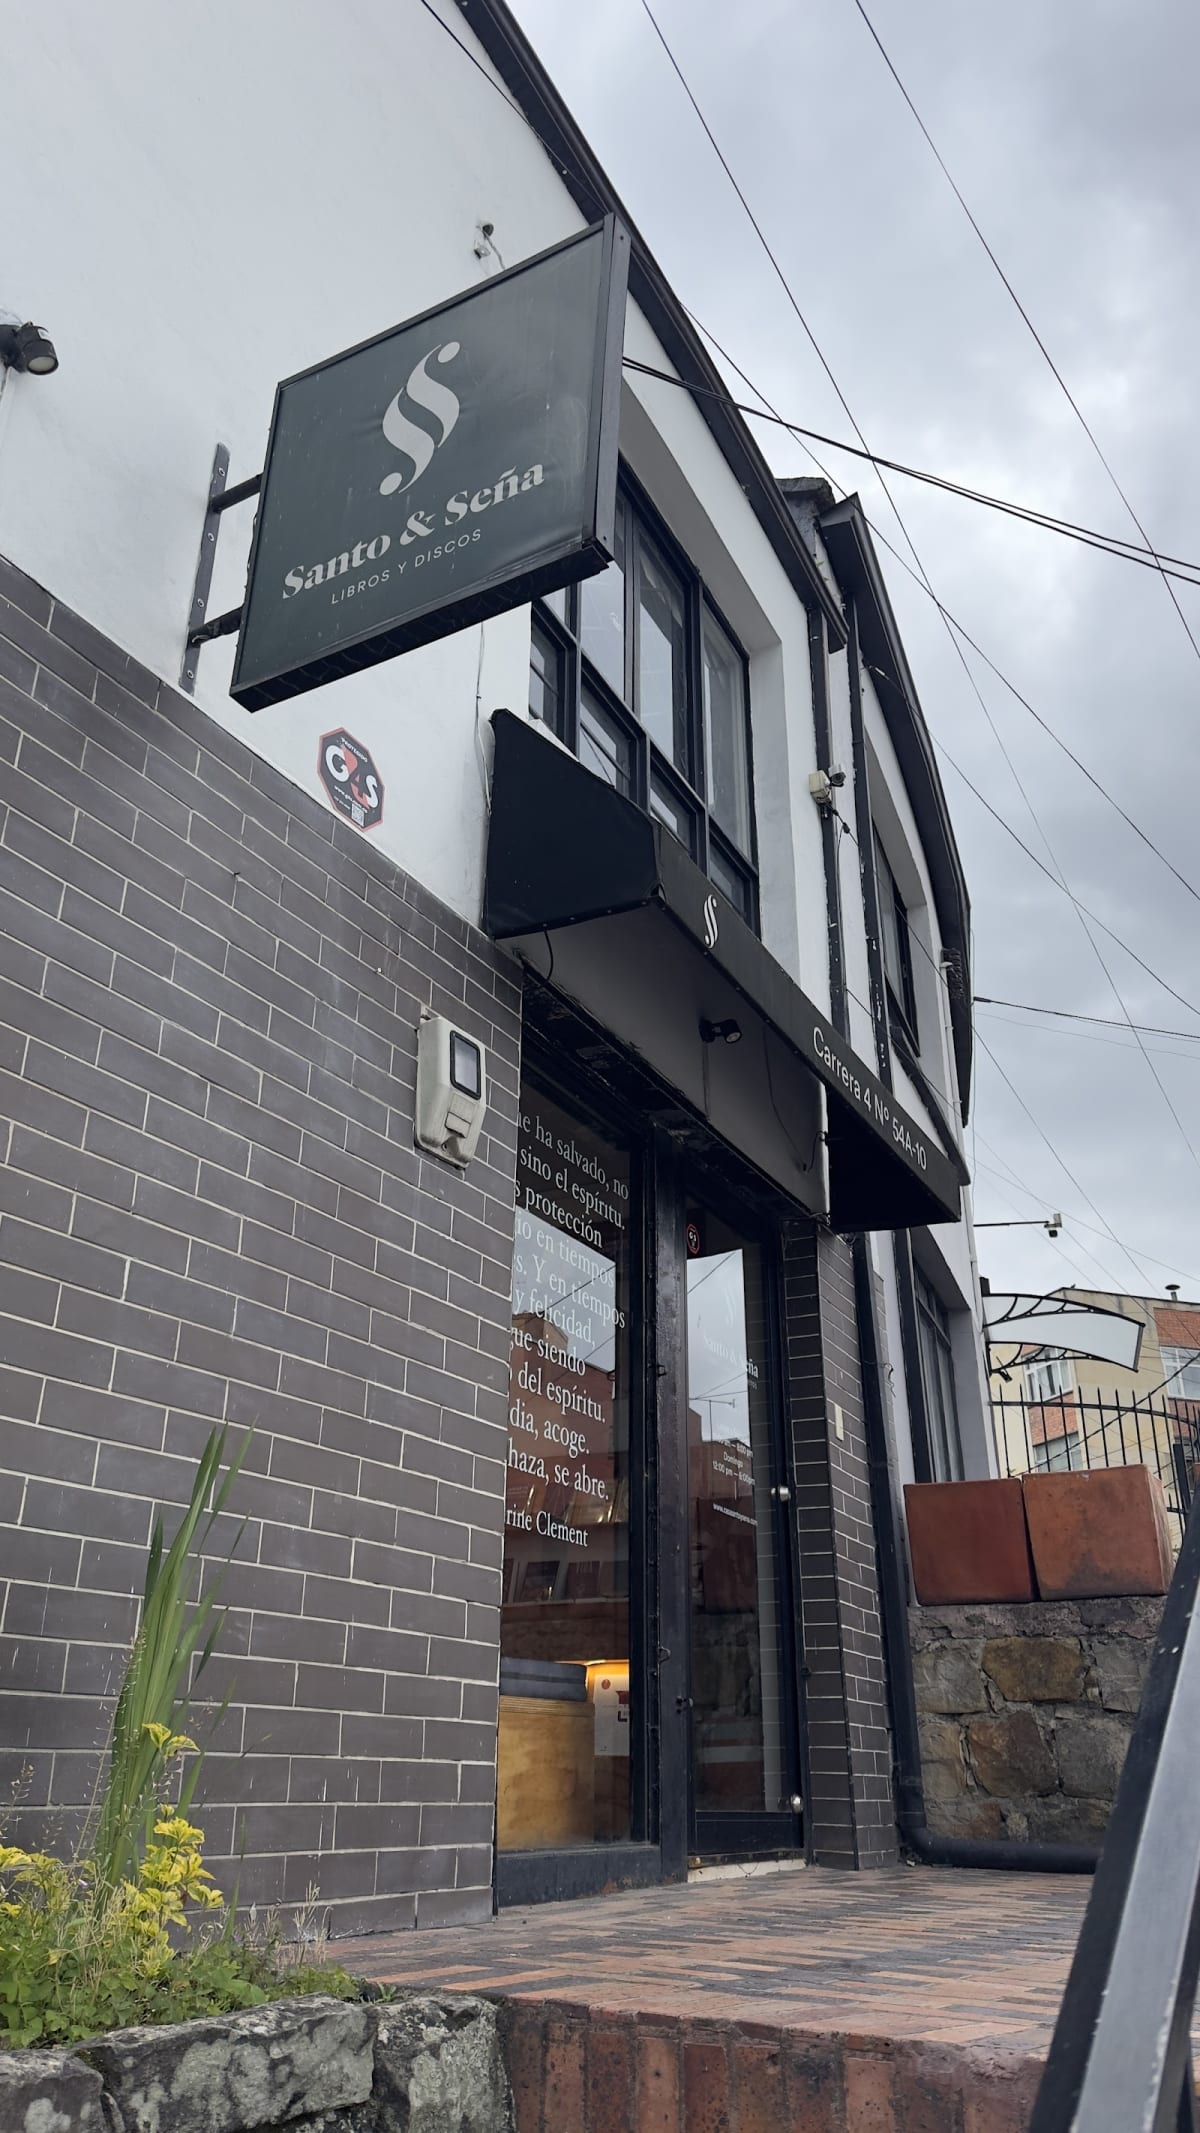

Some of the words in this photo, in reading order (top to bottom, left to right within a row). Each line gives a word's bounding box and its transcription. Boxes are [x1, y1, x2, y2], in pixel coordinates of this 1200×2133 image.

[282, 534, 391, 600] Santo
[400, 510, 436, 546] &
[444, 464, 545, 526] Seña
[331, 569, 391, 605] LIBROS
[397, 561, 407, 575] Y
[414, 528, 482, 568] DISCOS
[325, 745, 379, 808] G4S
[813, 1026, 861, 1101] Carrera
[863, 1087, 872, 1112] 4
[892, 1116, 927, 1171] 54A-10
[520, 1145, 552, 1181] sino
[555, 1168, 569, 1193] el
[571, 1182, 625, 1230] espíritu.
[535, 1115, 553, 1149] ha
[556, 1139, 610, 1192] salvado,
[613, 1178, 629, 1200] no
[525, 1187, 603, 1249] protección
[536, 1229, 555, 1254] en
[559, 1239, 614, 1289] tiempos
[513, 1254, 527, 1276] s.
[532, 1254, 546, 1282] Y
[549, 1272, 567, 1297] en
[571, 1280, 625, 1329] tiempos
[514, 1288, 525, 1315] y
[529, 1288, 596, 1349] felicidad,
[537, 1333, 586, 1376] siendo
[518, 1361, 542, 1396] del
[546, 1381, 606, 1423] espíritu.
[509, 1398, 539, 1441] dia,
[543, 1419, 590, 1459] acoge.
[507, 1437, 550, 1486] haza,
[554, 1464, 570, 1487] se
[574, 1463, 609, 1500] abre.
[506, 1503, 532, 1531] rine
[536, 1510, 588, 1548] Clement
